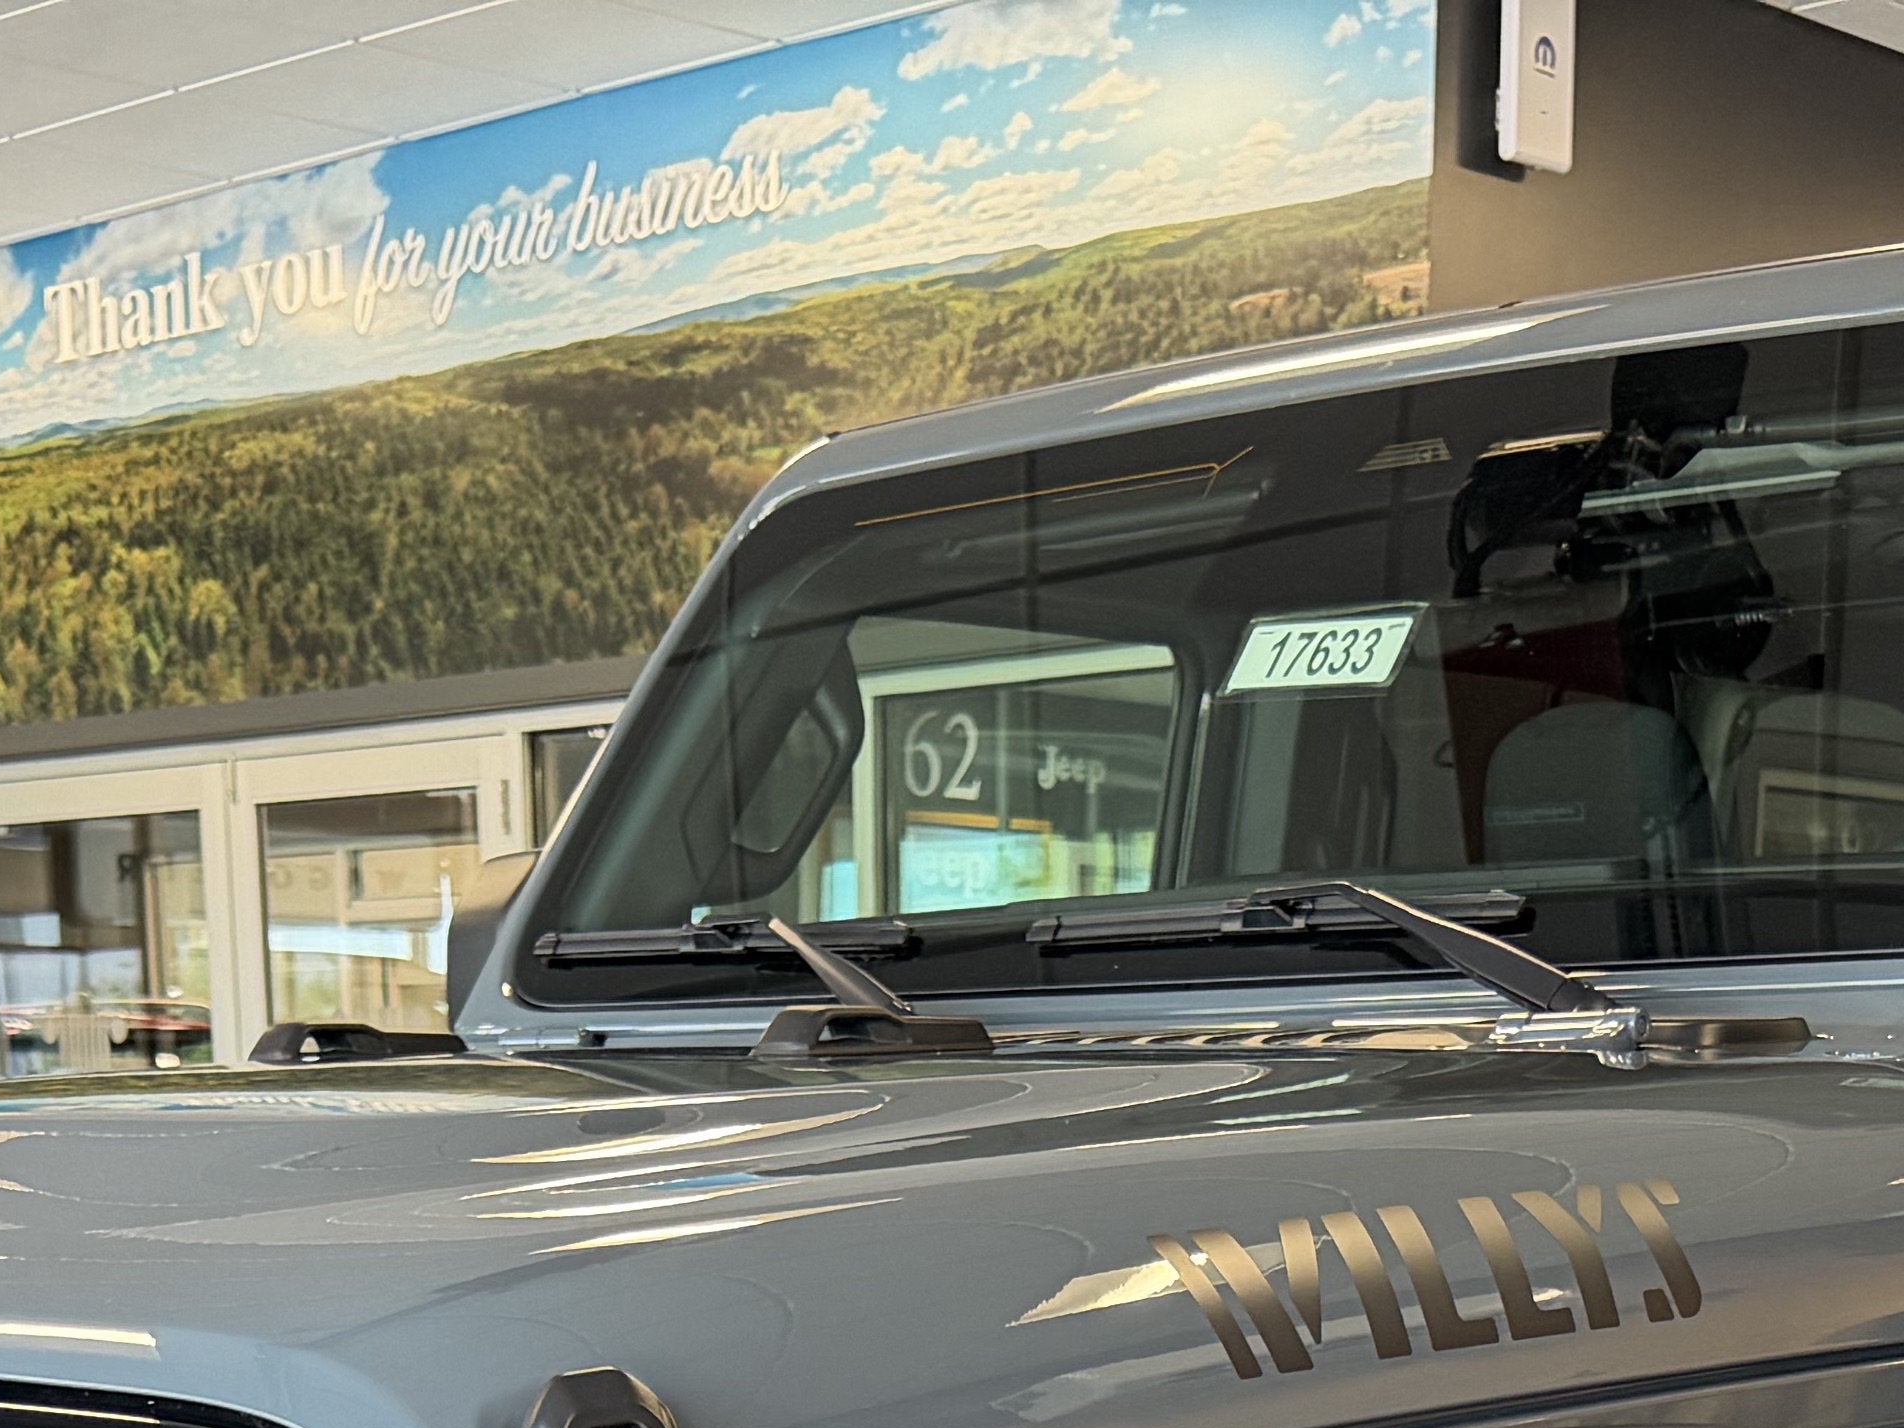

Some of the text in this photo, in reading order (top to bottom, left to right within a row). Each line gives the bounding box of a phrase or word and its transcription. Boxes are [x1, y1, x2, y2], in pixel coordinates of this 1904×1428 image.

[44, 147, 796, 362] Thank you for your business
[1265, 627, 1383, 679] 17633
[903, 709, 982, 801] 62
[1036, 745, 1107, 795] Jeep
[1146, 1178, 1702, 1380] WILLYS
